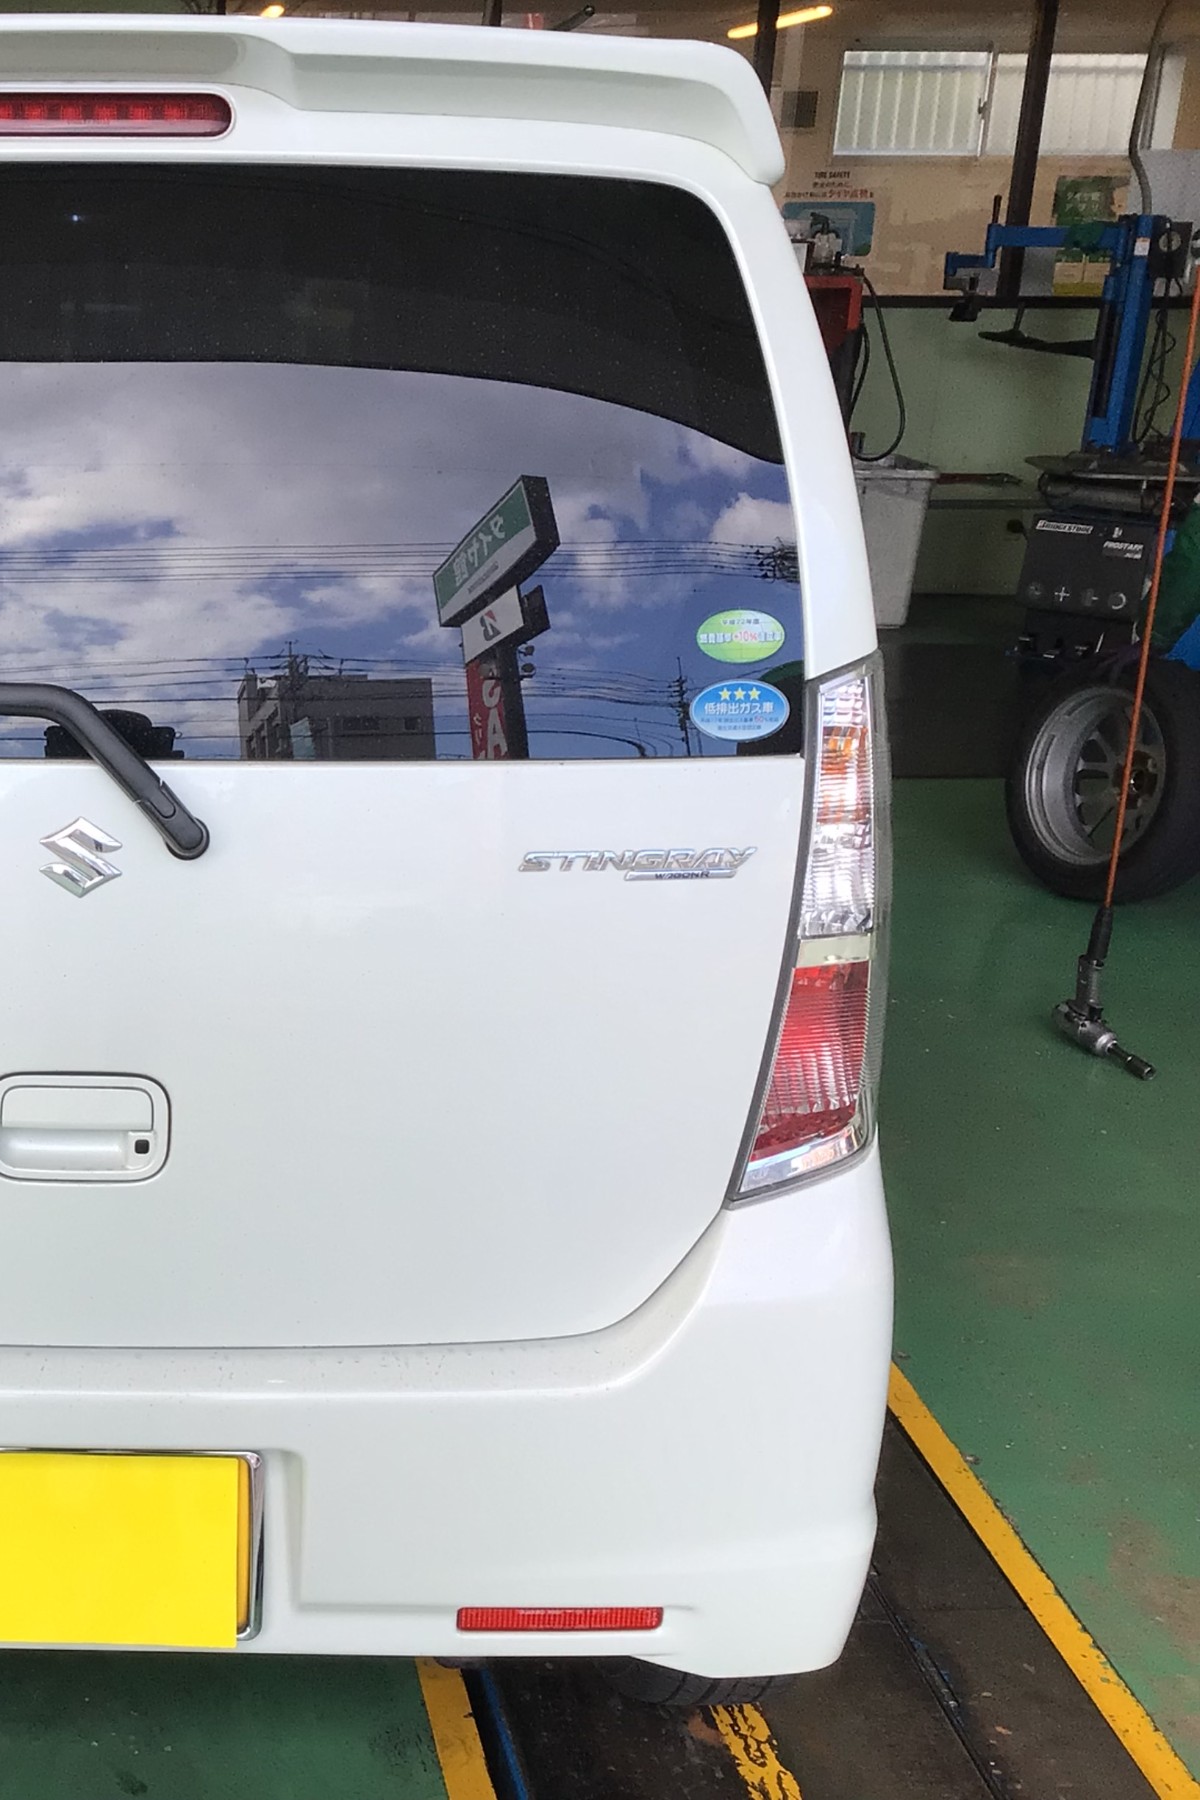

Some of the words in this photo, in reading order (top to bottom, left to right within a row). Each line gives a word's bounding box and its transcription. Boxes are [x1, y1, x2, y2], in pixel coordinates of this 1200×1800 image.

[704, 701, 775, 715] 低排出ガス車
[518, 846, 758, 873] STINGRAY
